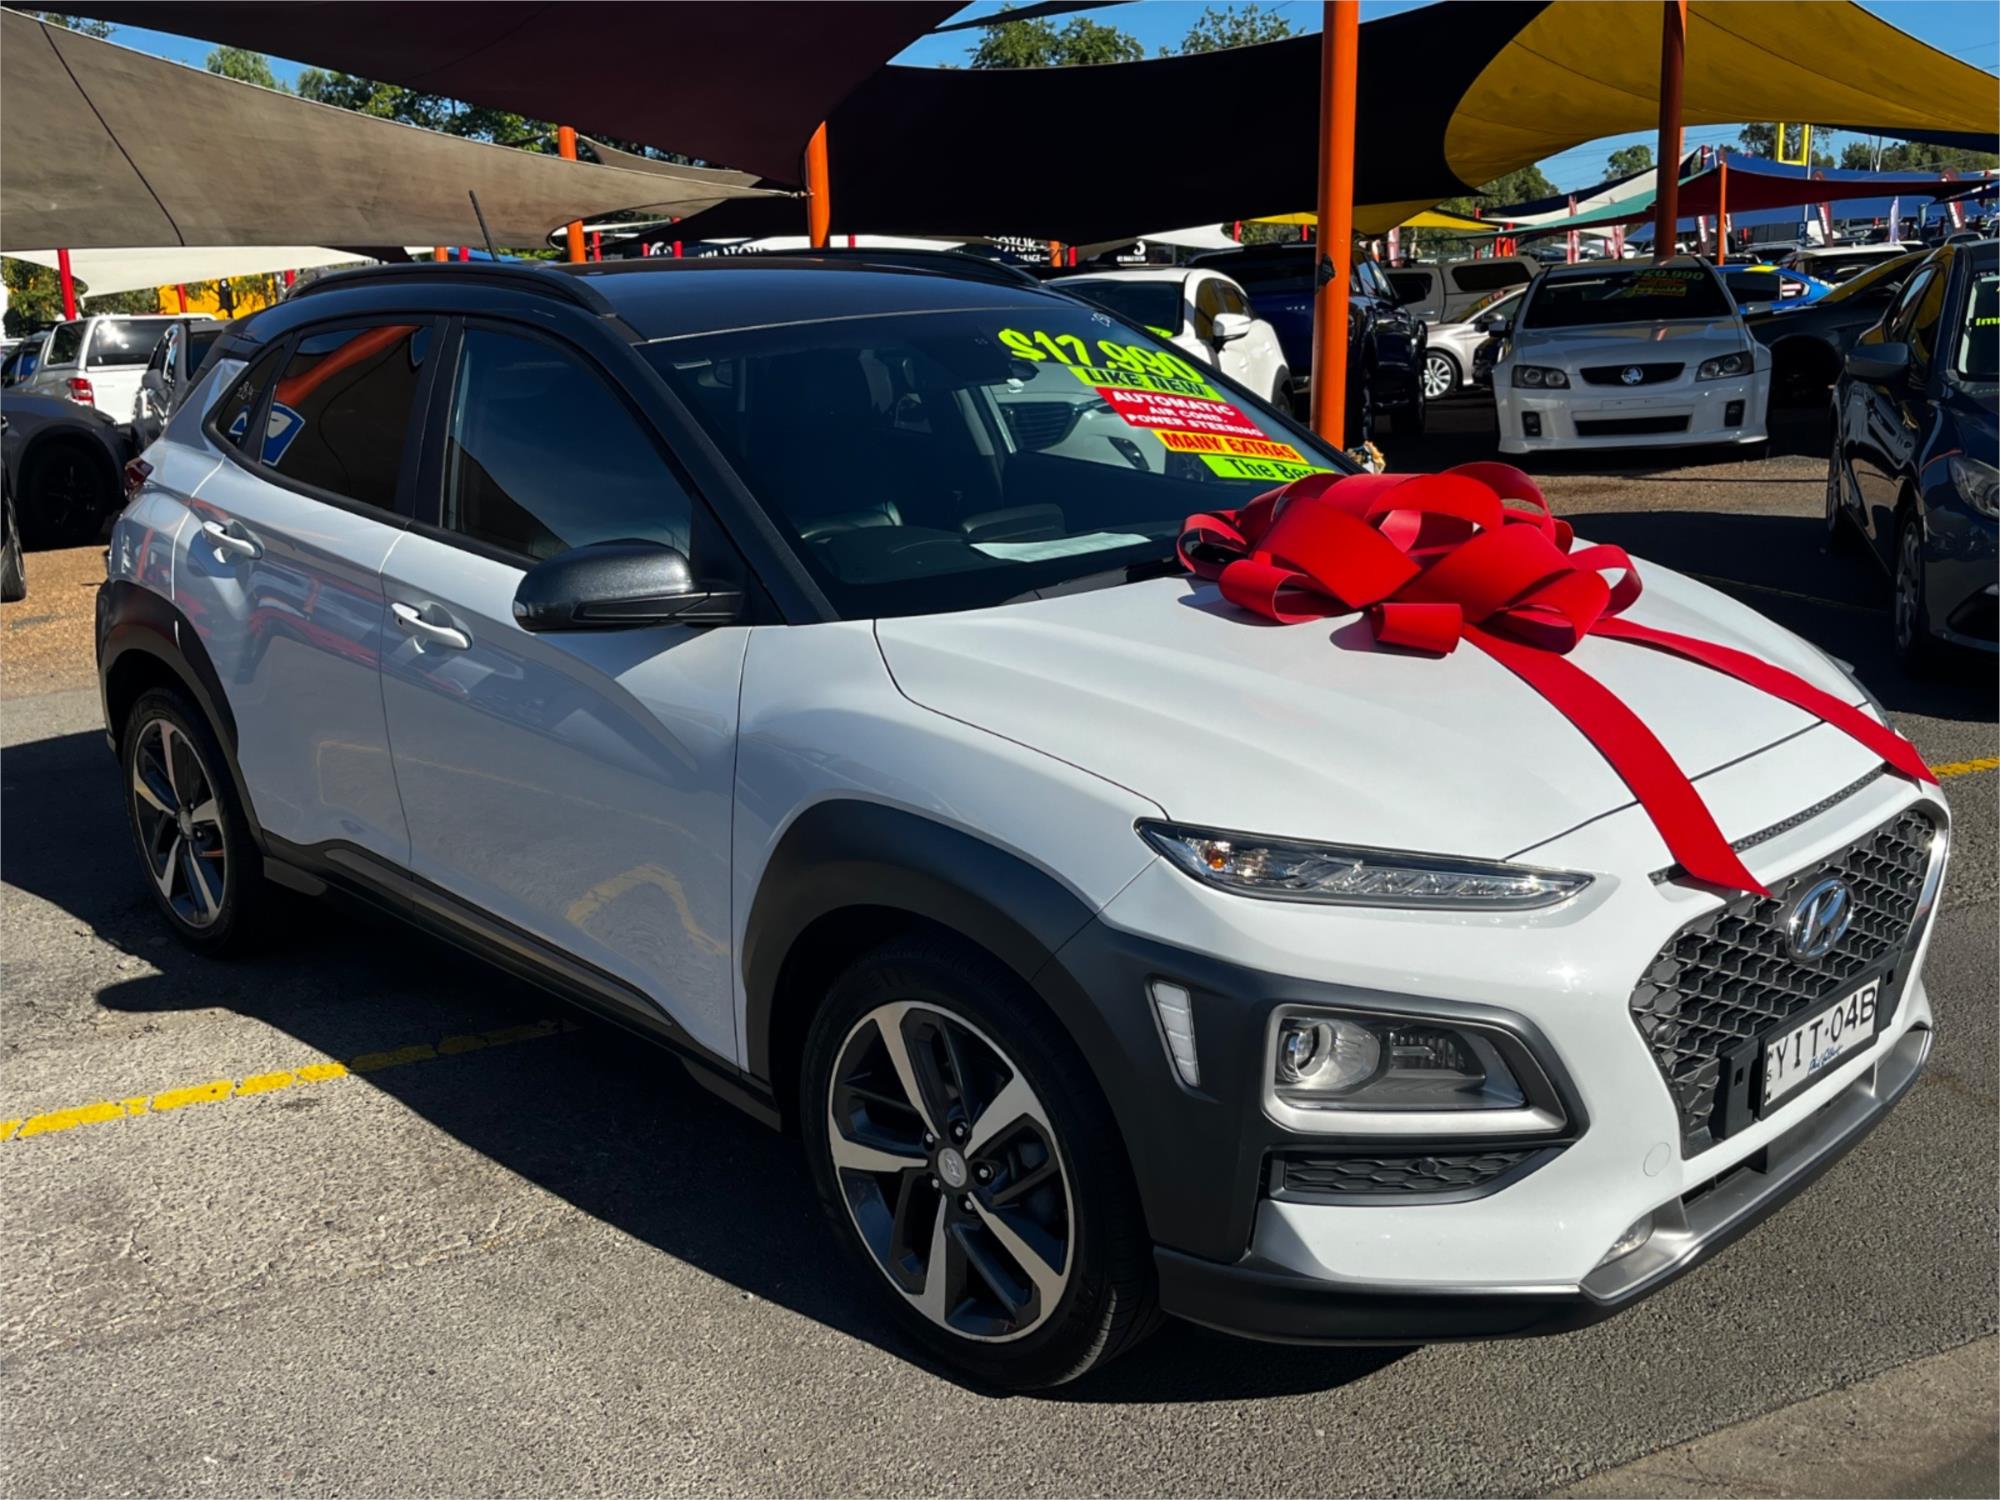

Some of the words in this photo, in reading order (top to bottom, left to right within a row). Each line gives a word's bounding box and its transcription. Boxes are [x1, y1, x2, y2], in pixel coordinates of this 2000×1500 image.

[1085, 368, 1146, 386] LIKE
[1149, 375, 1208, 396] NEW
[1112, 391, 1236, 416] AUTOMATIC
[1149, 406, 1177, 417] AIR
[1126, 413, 1187, 427] POWER
[1189, 419, 1265, 437] STEERING
[1161, 432, 1224, 451] MANY
[1224, 438, 1300, 461] EXTRAS
[1225, 458, 1276, 478] The
